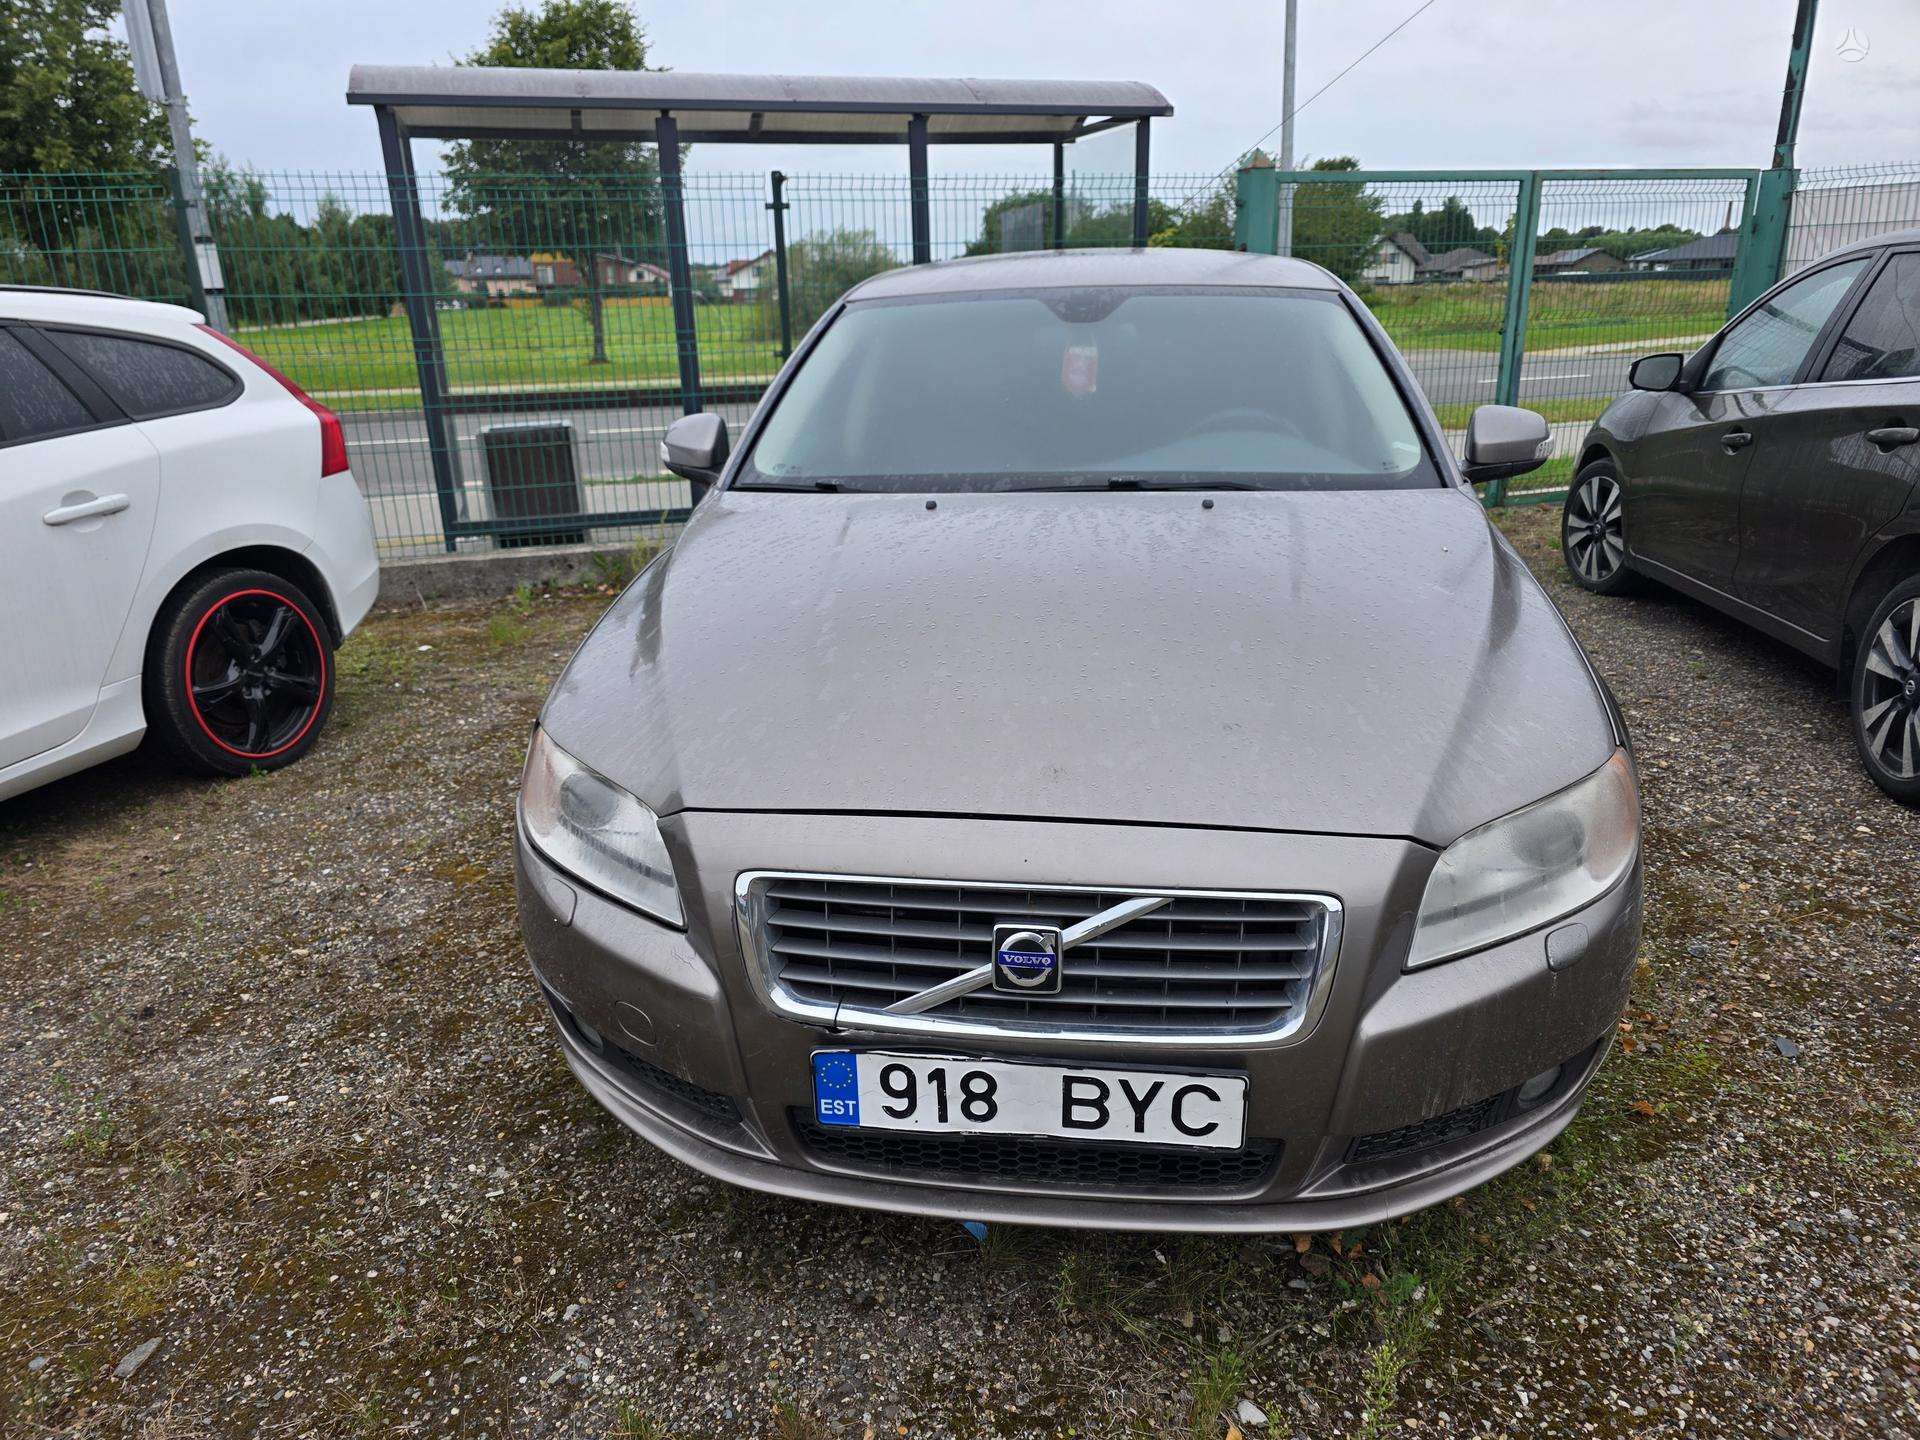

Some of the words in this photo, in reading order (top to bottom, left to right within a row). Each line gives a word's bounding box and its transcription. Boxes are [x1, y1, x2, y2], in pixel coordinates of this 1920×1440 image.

[1003, 954, 1051, 966] VOLVO
[820, 1098, 857, 1116] EST
[879, 1063, 998, 1123] 918
[1061, 1075, 1221, 1138] BYC
